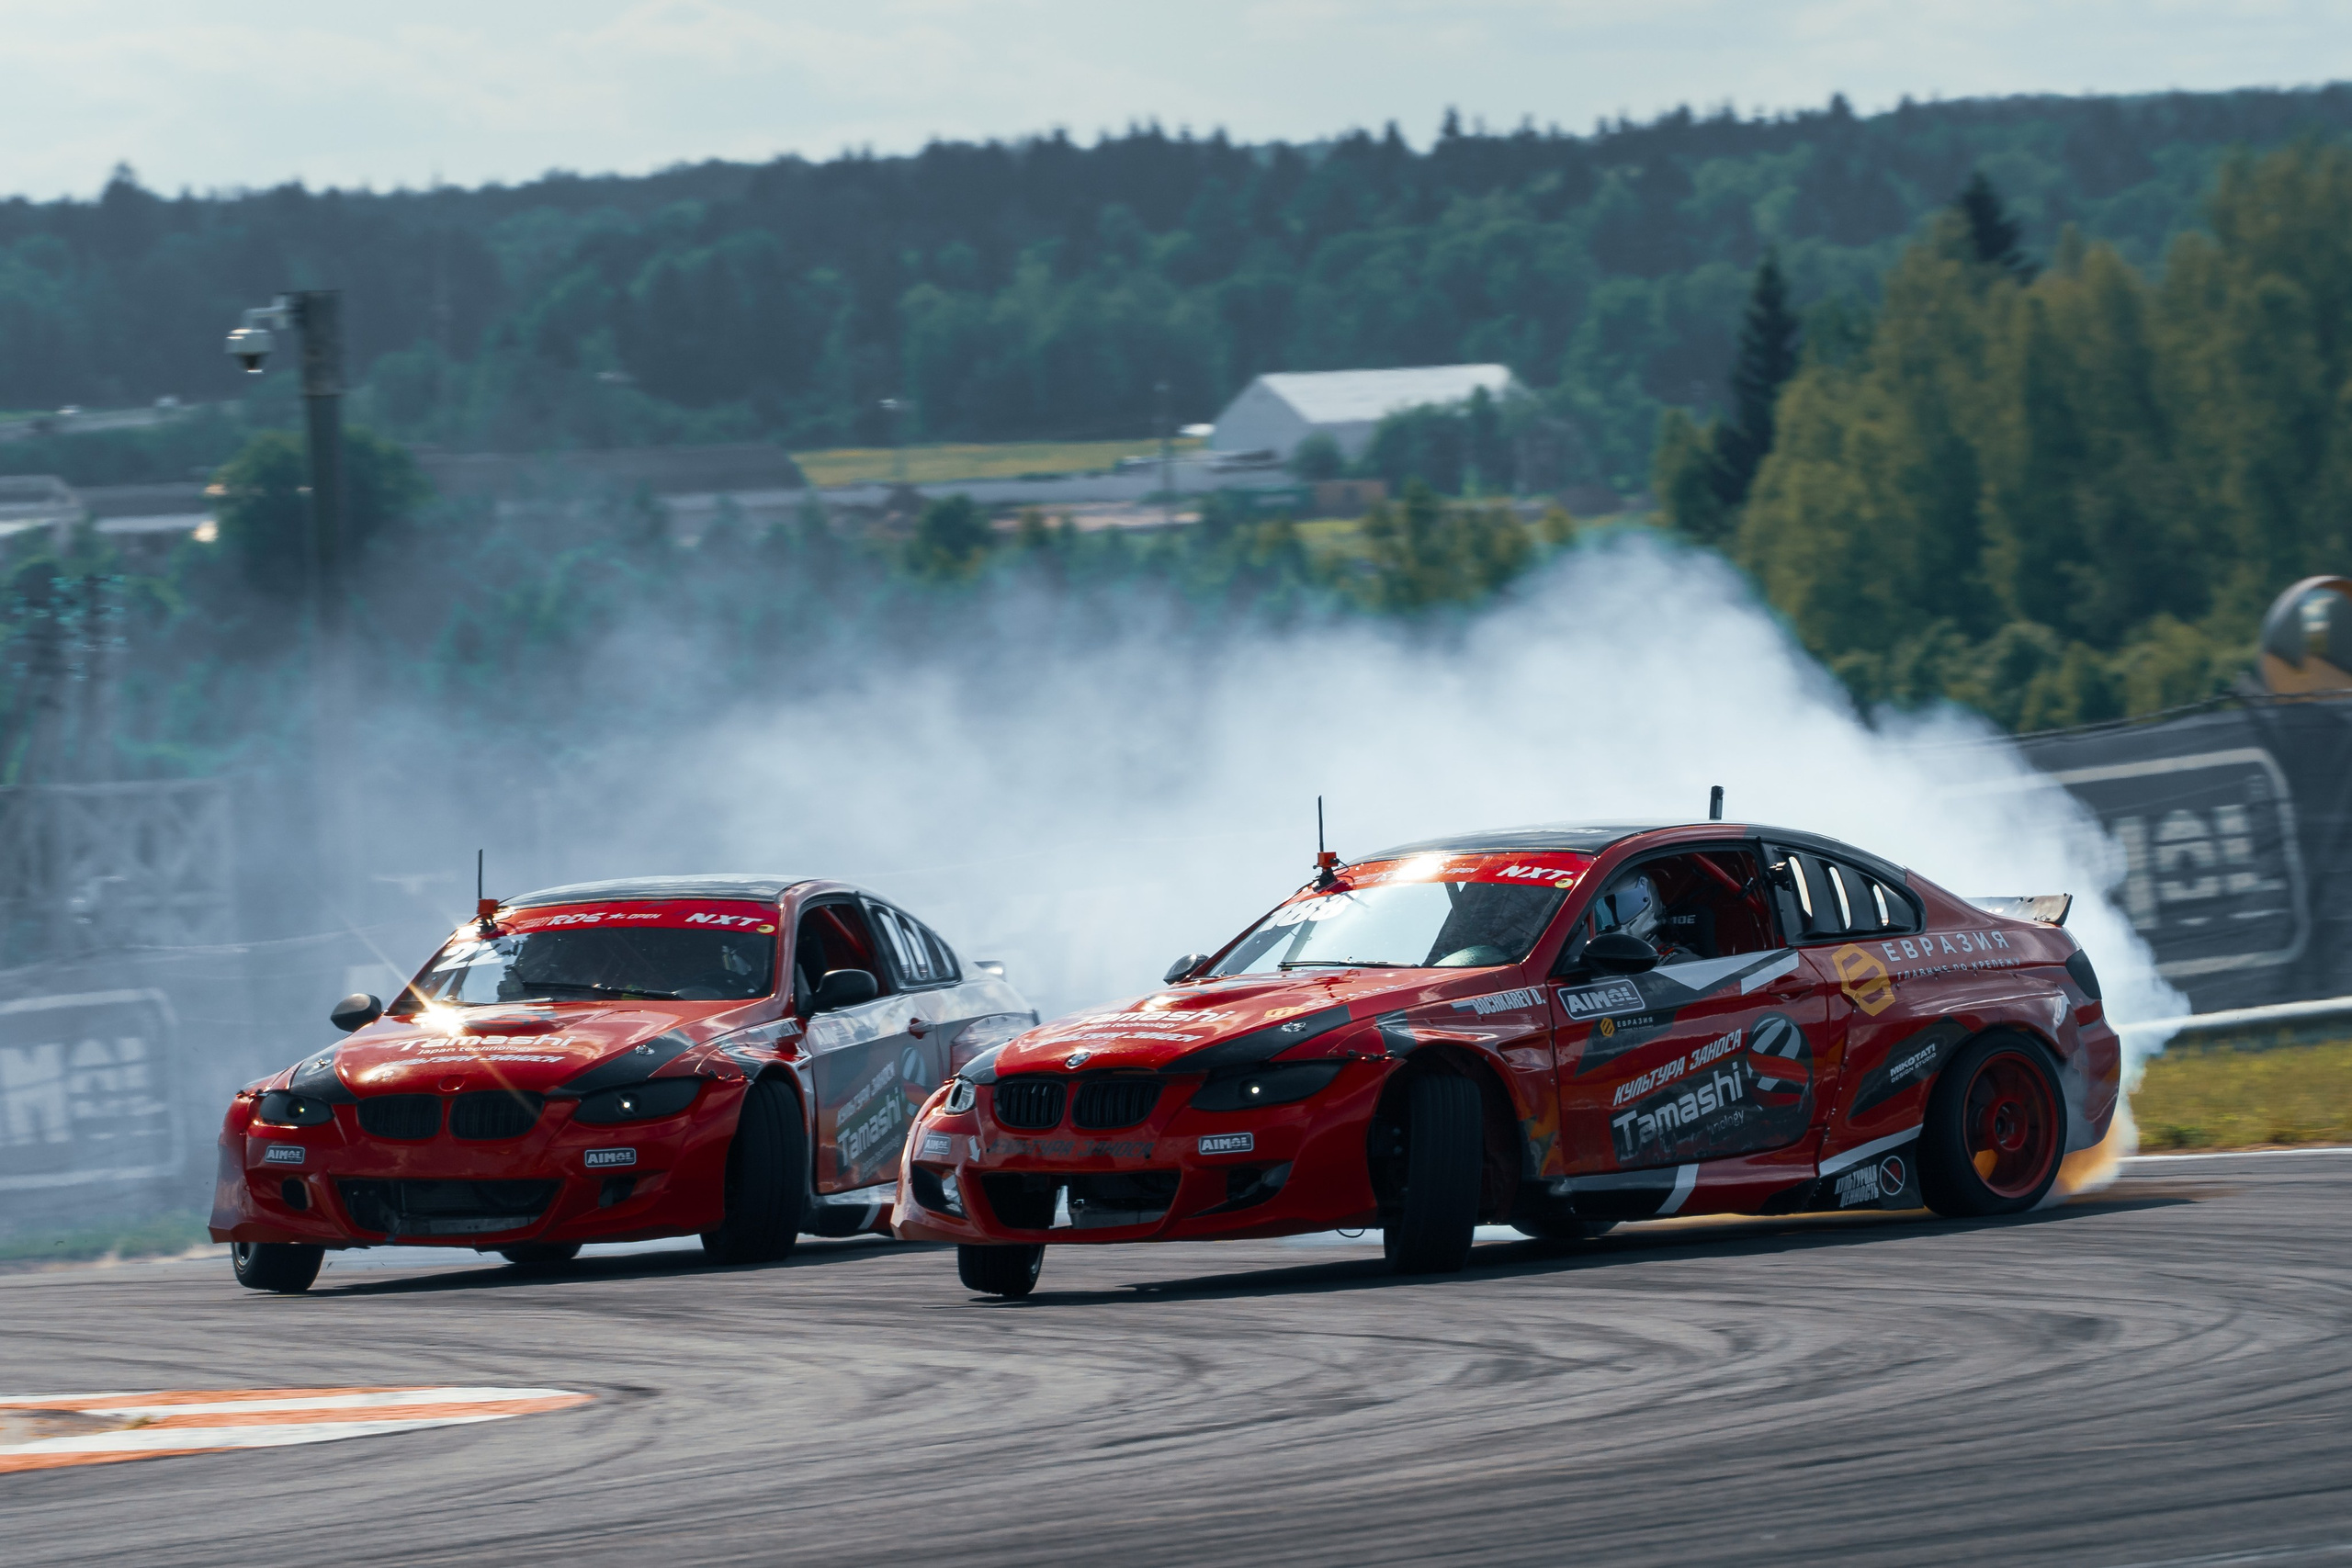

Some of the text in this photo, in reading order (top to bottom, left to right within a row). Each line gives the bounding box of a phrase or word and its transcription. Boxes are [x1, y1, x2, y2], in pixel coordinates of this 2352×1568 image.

[1497, 865, 1575, 881] NXT
[547, 912, 608, 927] RDS
[684, 912, 763, 927] NXT
[1882, 931, 2009, 962] ЕВРАЗИЯ
[1973, 957, 2020, 970] КРЕПЕЖУ
[1472, 988, 1546, 1015] BOCHKAREV D.
[1566, 987, 1640, 1013] AIMOL
[1617, 1016, 1654, 1028] ЕВРАЗИЯ
[397, 1033, 577, 1052] Tamashi
[1613, 1028, 1742, 1107] КУЛЬТУРА ЗАНОСА
[1890, 1043, 1936, 1077] MIKOTATI
[1891, 1052, 1937, 1083] DESIGN STUDIO
[1613, 1061, 1744, 1152] Tamashi
[837, 1087, 902, 1168] Tamashi
[1202, 1136, 1250, 1151] AIMOL
[266, 1149, 302, 1161] AIMOL
[587, 1151, 634, 1164] AIMOL
